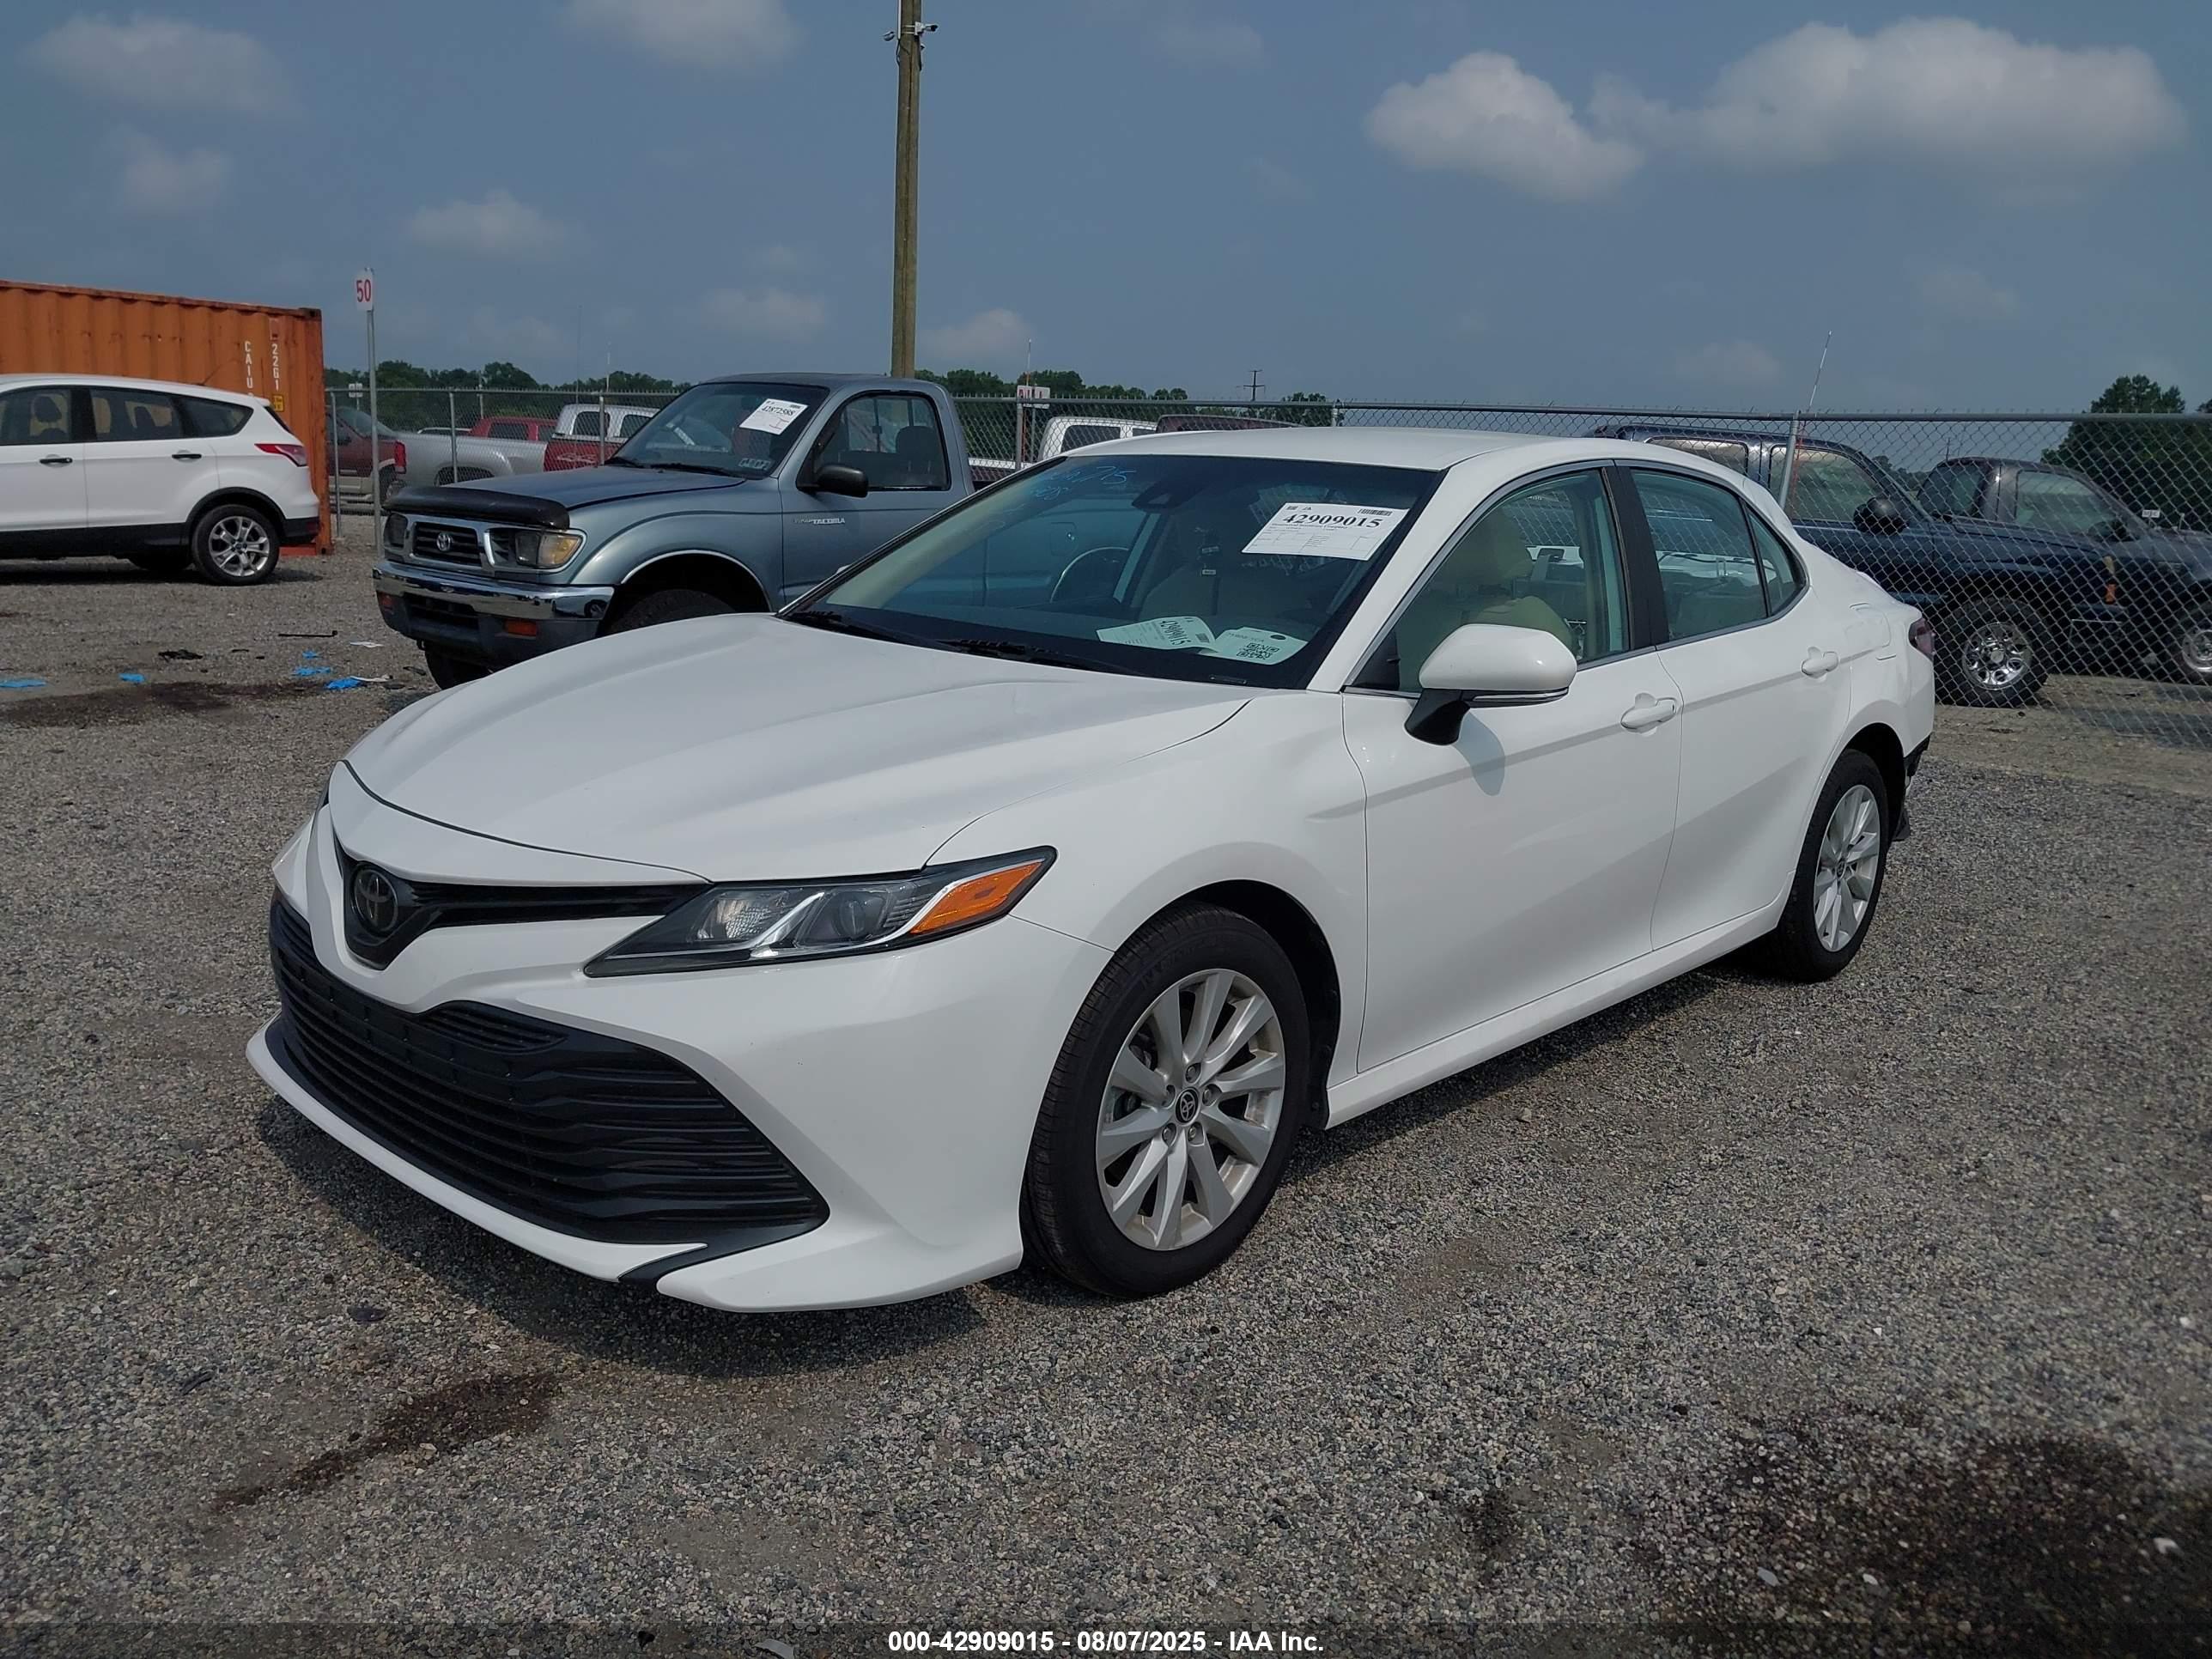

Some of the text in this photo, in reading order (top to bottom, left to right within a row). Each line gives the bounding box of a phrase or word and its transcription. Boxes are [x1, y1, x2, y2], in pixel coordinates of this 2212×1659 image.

[356, 279, 371, 302] 50
[245, 341, 253, 388] CAIU
[1283, 514, 1382, 528] 42909015
